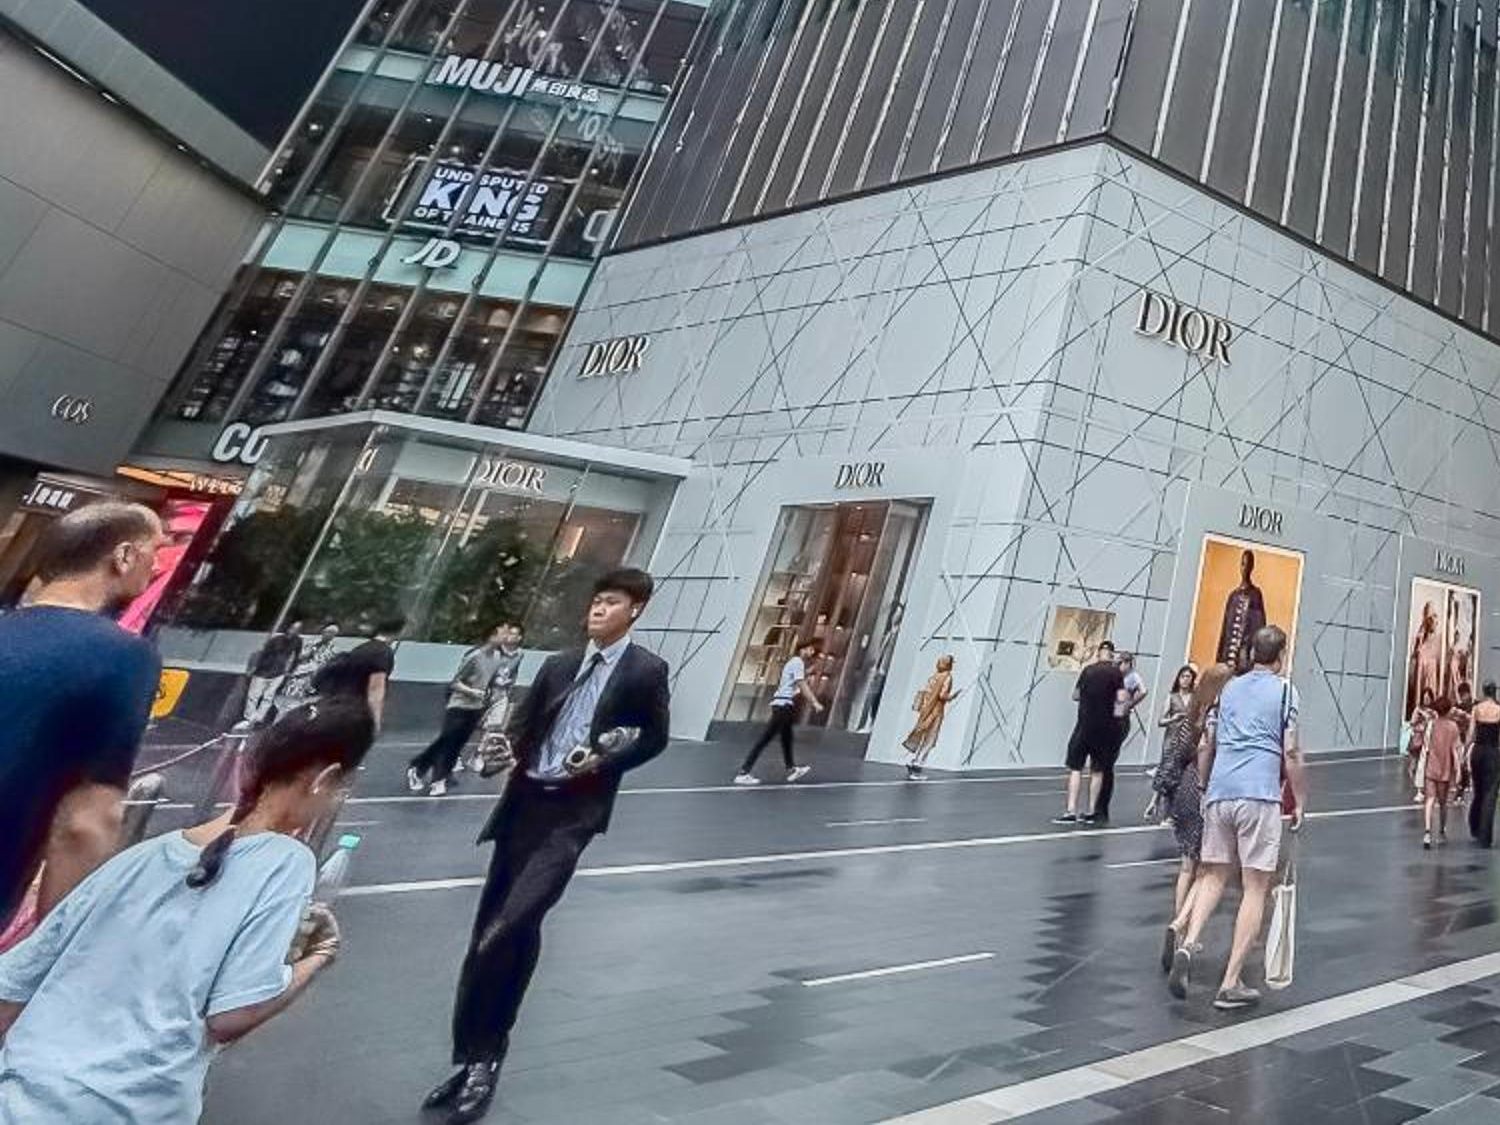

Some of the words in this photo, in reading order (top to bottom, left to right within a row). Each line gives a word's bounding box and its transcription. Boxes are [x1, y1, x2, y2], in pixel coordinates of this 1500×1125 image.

[434, 55, 535, 97] MUJI
[435, 167, 549, 194] UNDSPUTD
[442, 210, 532, 233] TAINERS
[403, 238, 461, 268] JD
[1134, 290, 1232, 366] DIOR
[576, 335, 650, 379] DIOR
[51, 393, 95, 423] COS
[833, 461, 885, 489] DIOR
[1239, 503, 1284, 536] DIOR
